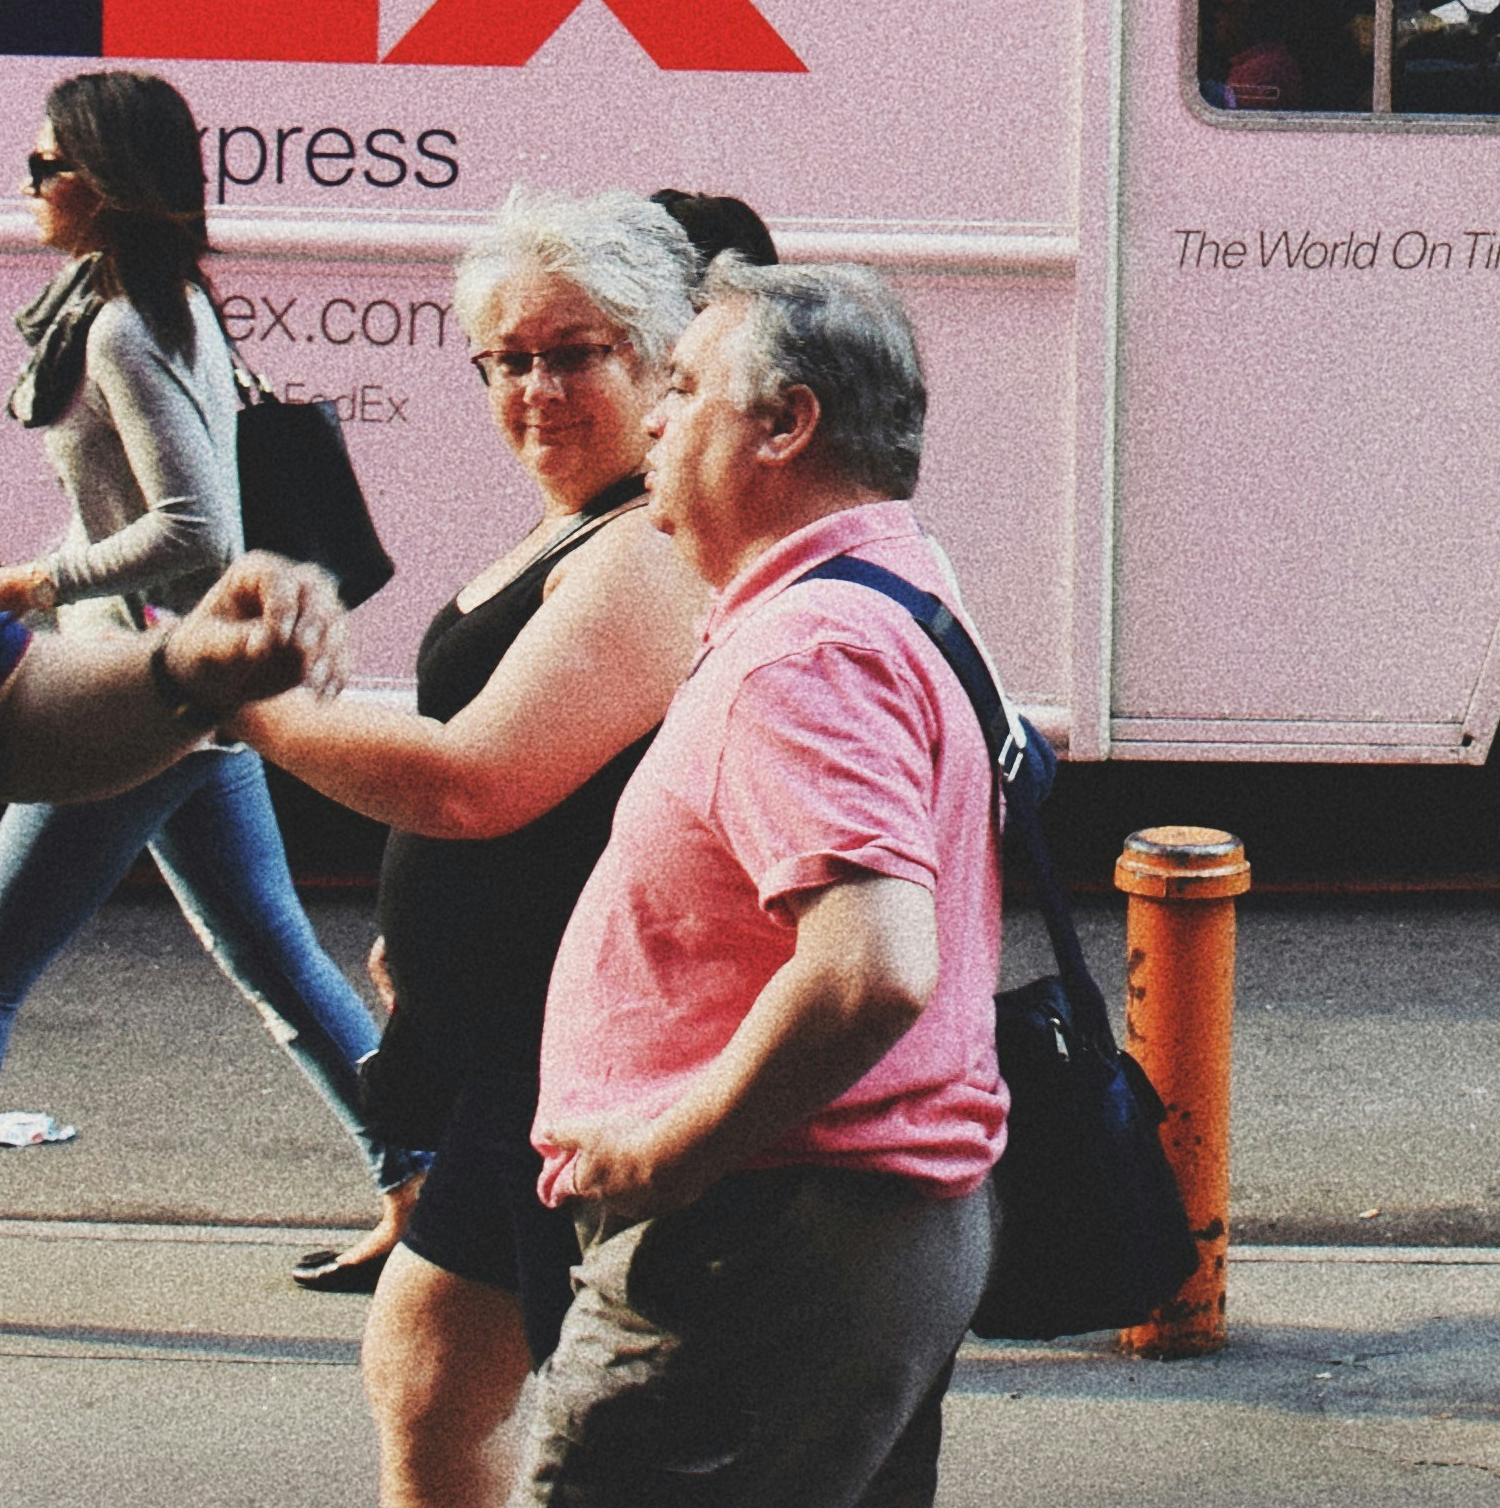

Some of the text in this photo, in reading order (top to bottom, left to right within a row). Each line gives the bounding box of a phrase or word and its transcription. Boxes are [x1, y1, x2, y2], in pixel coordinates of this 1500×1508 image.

[201, 125, 460, 205] press
[1175, 229, 1248, 270] The
[1258, 229, 1379, 271] World
[1393, 230, 1453, 271] On
